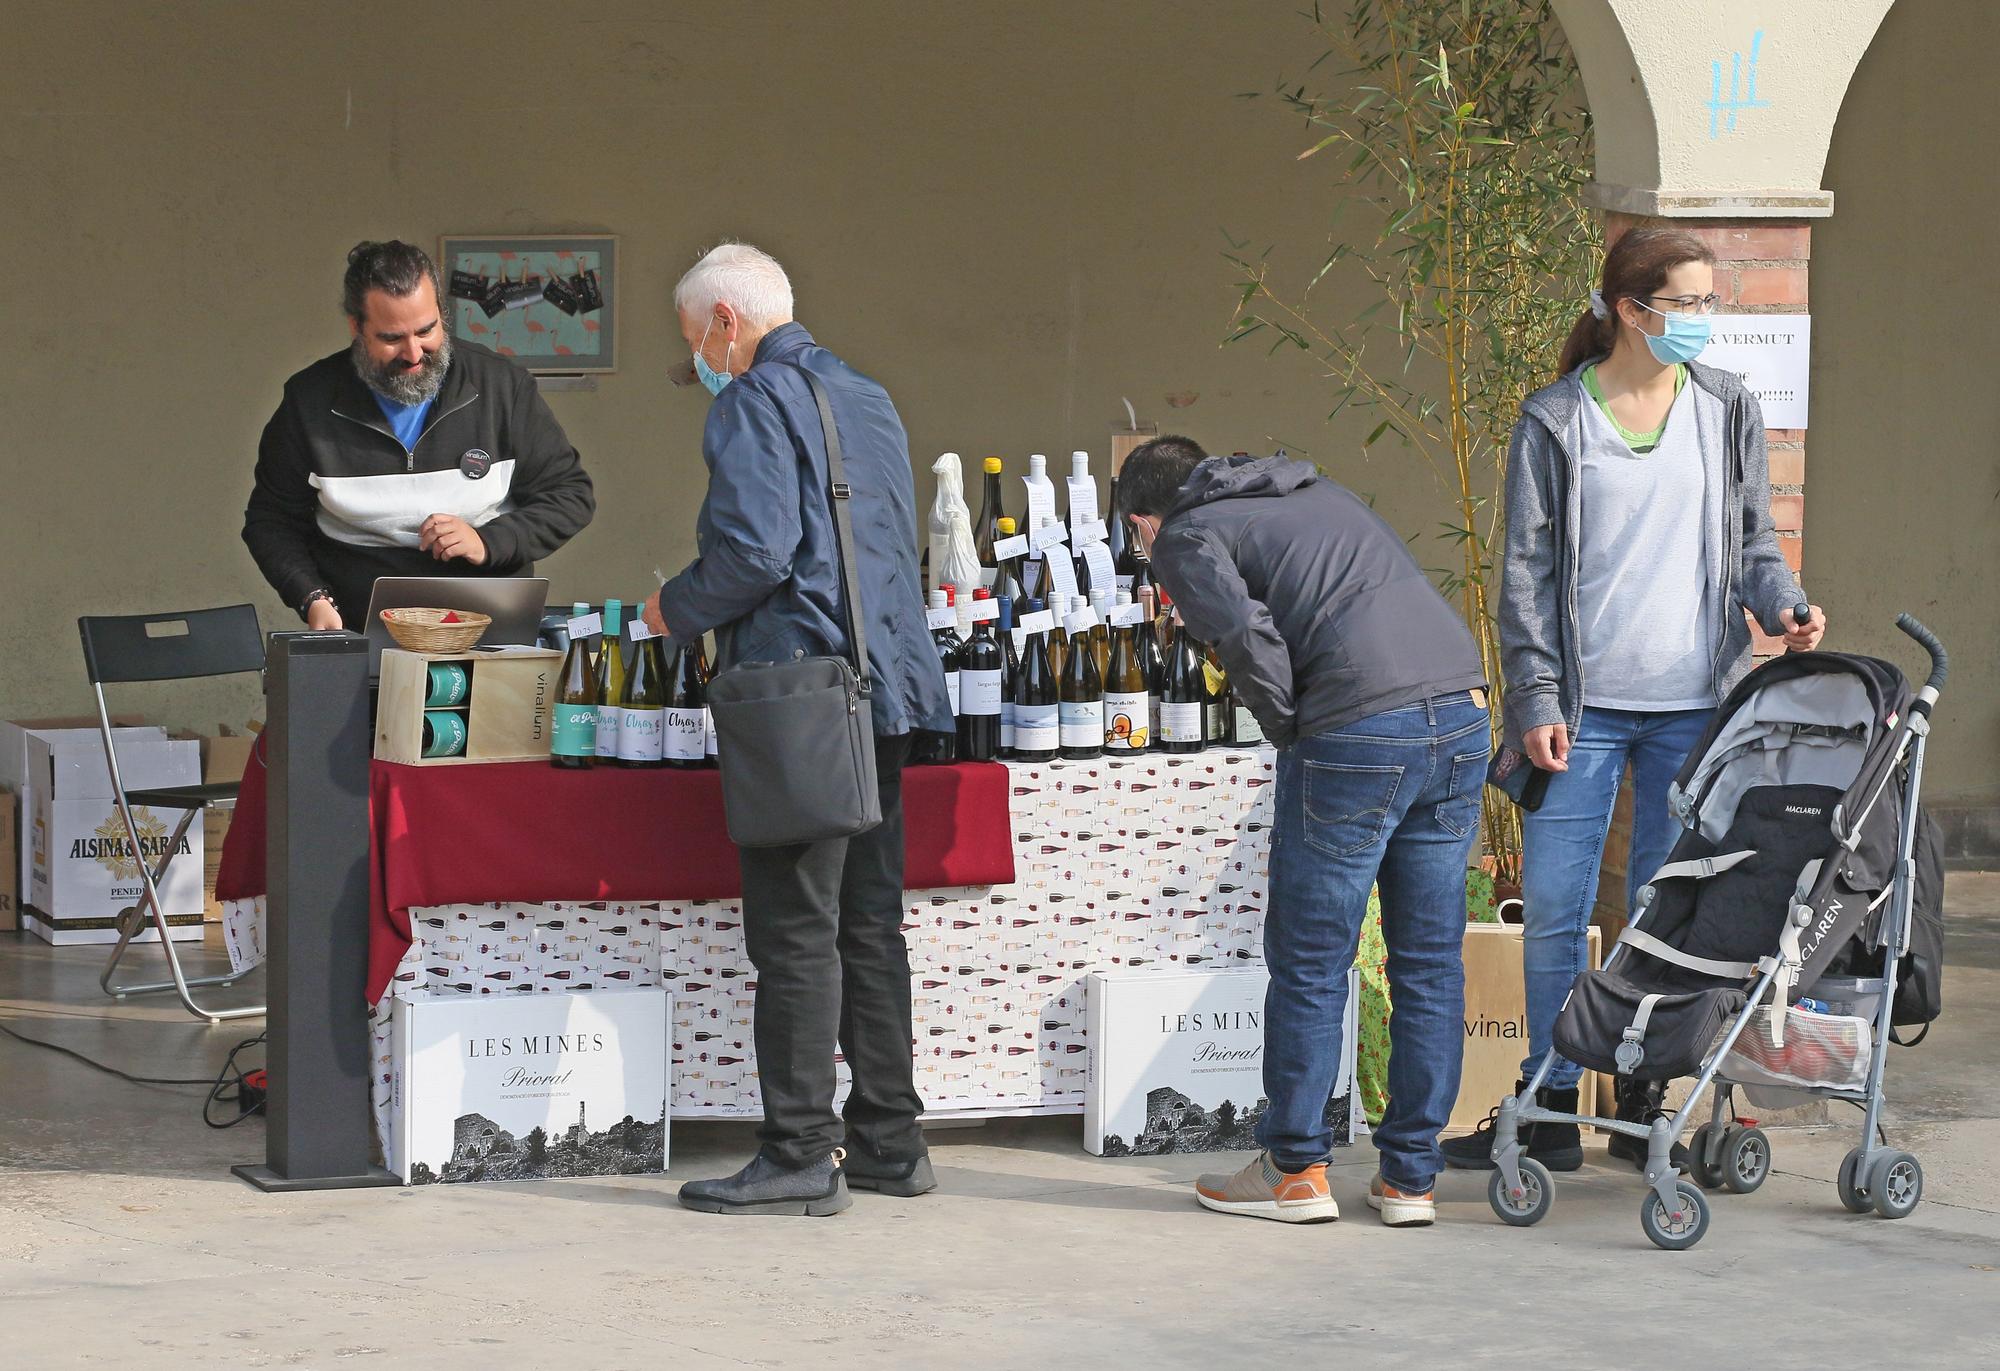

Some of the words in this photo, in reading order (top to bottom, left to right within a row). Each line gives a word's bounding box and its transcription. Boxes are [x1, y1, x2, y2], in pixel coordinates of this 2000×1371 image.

[1721, 333, 1795, 345] VERMUT
[533, 672, 548, 740] vinalium
[1784, 804, 1822, 816] MACLAREN
[69, 838, 124, 859] ALSINA
[1161, 1013, 1203, 1034] LES
[1212, 1010, 1260, 1032] MIN
[1464, 1013, 1530, 1038] vinal
[469, 1037, 512, 1058] LES
[522, 1032, 604, 1055] MINES
[1192, 1040, 1262, 1062] Priorat
[501, 1066, 574, 1088] Priorat
